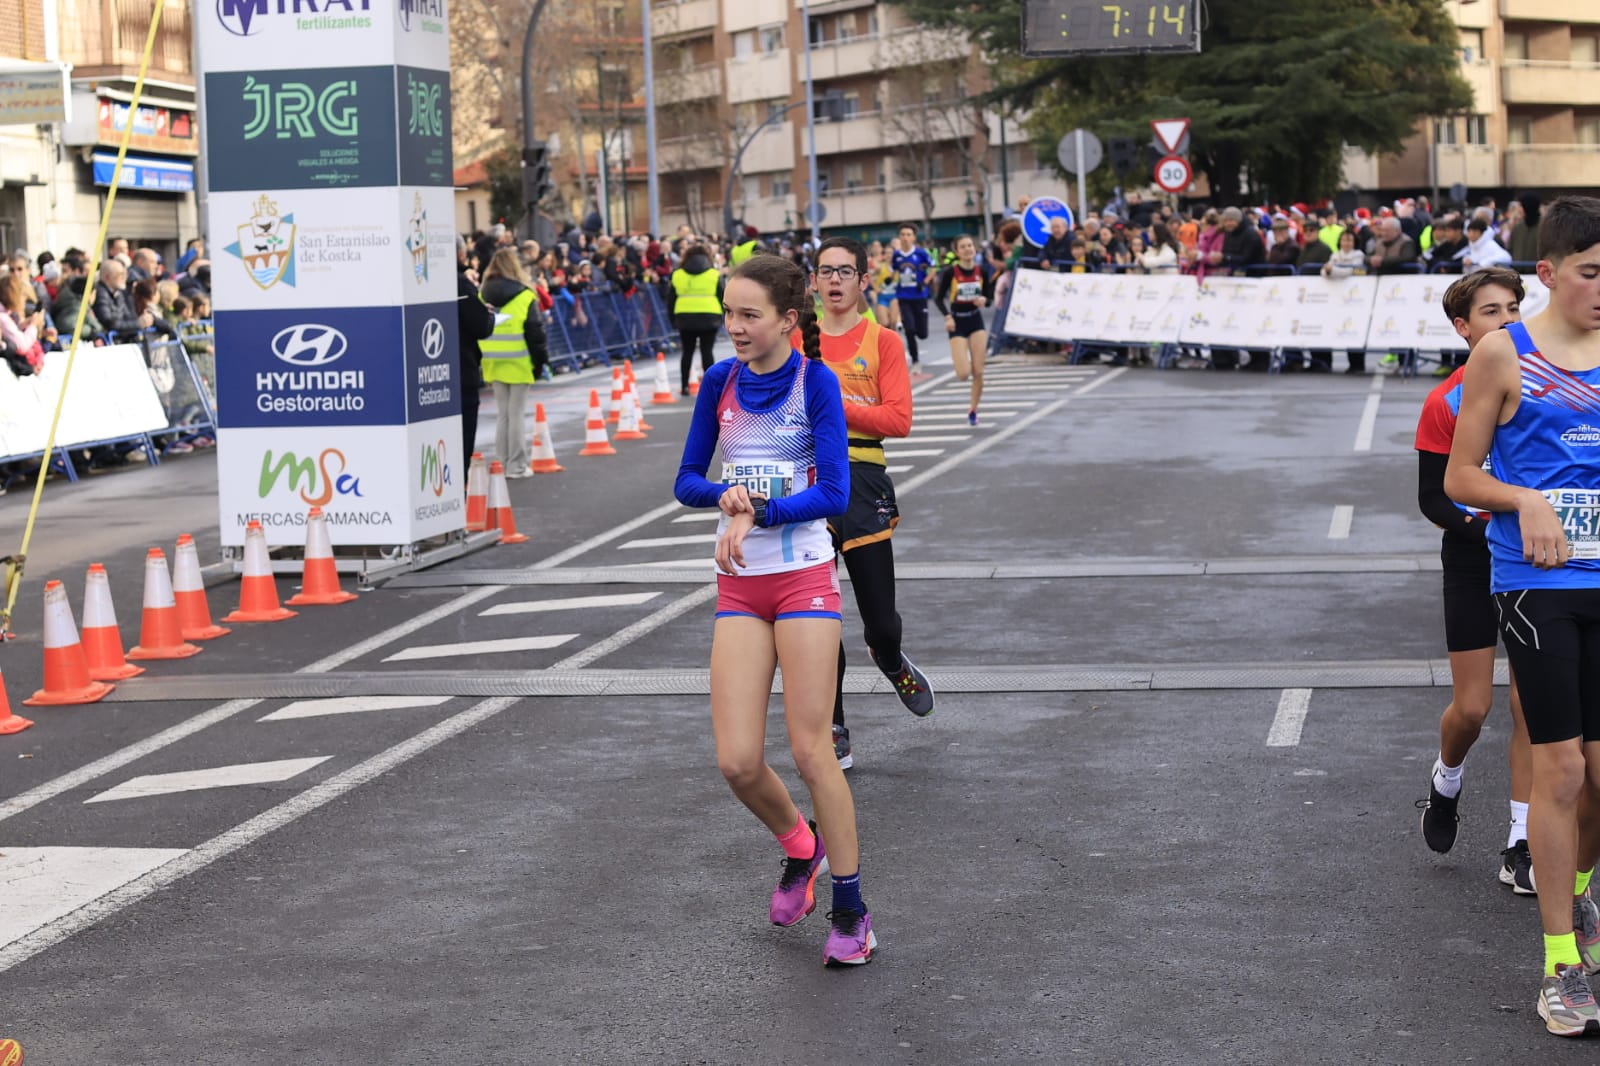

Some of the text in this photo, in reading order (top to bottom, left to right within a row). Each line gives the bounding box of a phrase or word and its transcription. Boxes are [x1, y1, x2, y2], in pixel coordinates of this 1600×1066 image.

[296, 16, 372, 30] fertilizantes
[243, 76, 358, 139] JRG
[1163, 168, 1183, 180] 30
[300, 233, 391, 249] San Estanislao
[300, 249, 361, 263] de Kostka
[256, 370, 365, 391] HYUNDAI
[418, 363, 450, 385] HYUNDAI
[257, 393, 364, 412] Gestorauto
[418, 387, 450, 406] Gestorauto
[1560, 433, 1600, 441] CRONO
[735, 465, 784, 476] SETEL
[1562, 493, 1600, 504] SET
[237, 511, 393, 526] MERCASAMANCA
